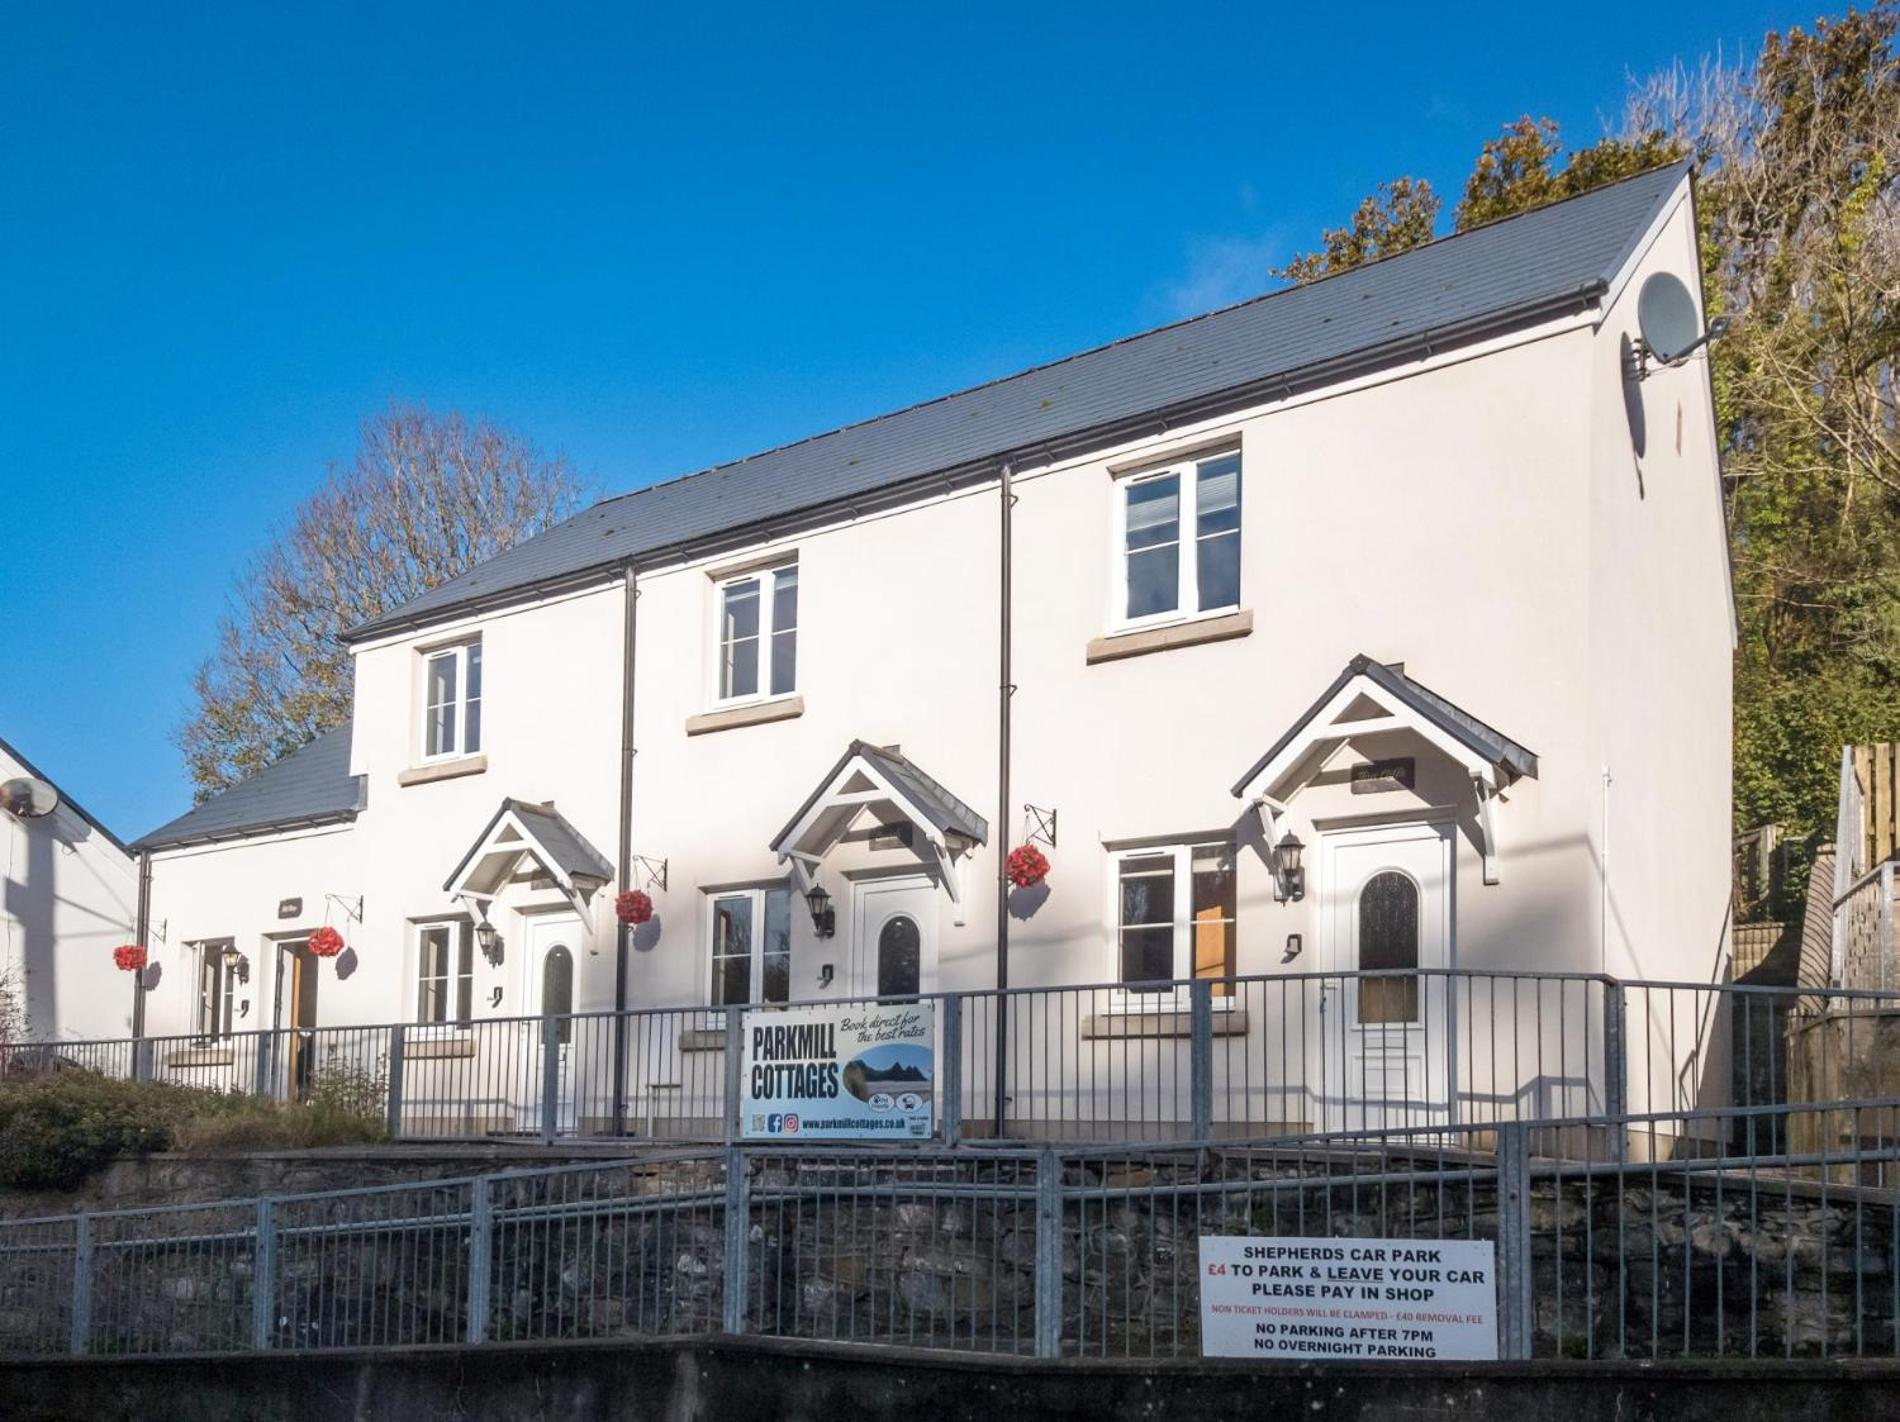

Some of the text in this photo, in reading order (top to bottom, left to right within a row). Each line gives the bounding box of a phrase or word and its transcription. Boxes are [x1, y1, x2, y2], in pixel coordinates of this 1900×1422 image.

[840, 1010, 920, 1032] Book direct for
[752, 1022, 837, 1061] PARKMILL
[857, 1023, 926, 1043] the best rates
[751, 1062, 840, 1100] COTTAGES
[802, 1117, 906, 1130] www.parkmillcottages.co.uk
[1244, 1246, 1441, 1263] SHEPHERDS CAR PARK
[1208, 1264, 1485, 1284] £4 TO PARK & LEAVE YOUR CAR
[1252, 1283, 1435, 1302] PLEASE PAY IN SHOP
[1211, 1304, 1232, 1314] NON
[1234, 1305, 1262, 1315] TICKET
[1264, 1306, 1304, 1317] HOLDERS
[1306, 1308, 1328, 1318] WILL
[1330, 1309, 1341, 1318] BE
[1343, 1309, 1388, 1320] CLAMPED
[1415, 1312, 1464, 1323] REMOVAL
[1466, 1314, 1483, 1324] FEE
[1256, 1323, 1433, 1342] NO PARKING AFTER 7PM
[1254, 1339, 1437, 1358] NO OVERNIGHT PARKING
